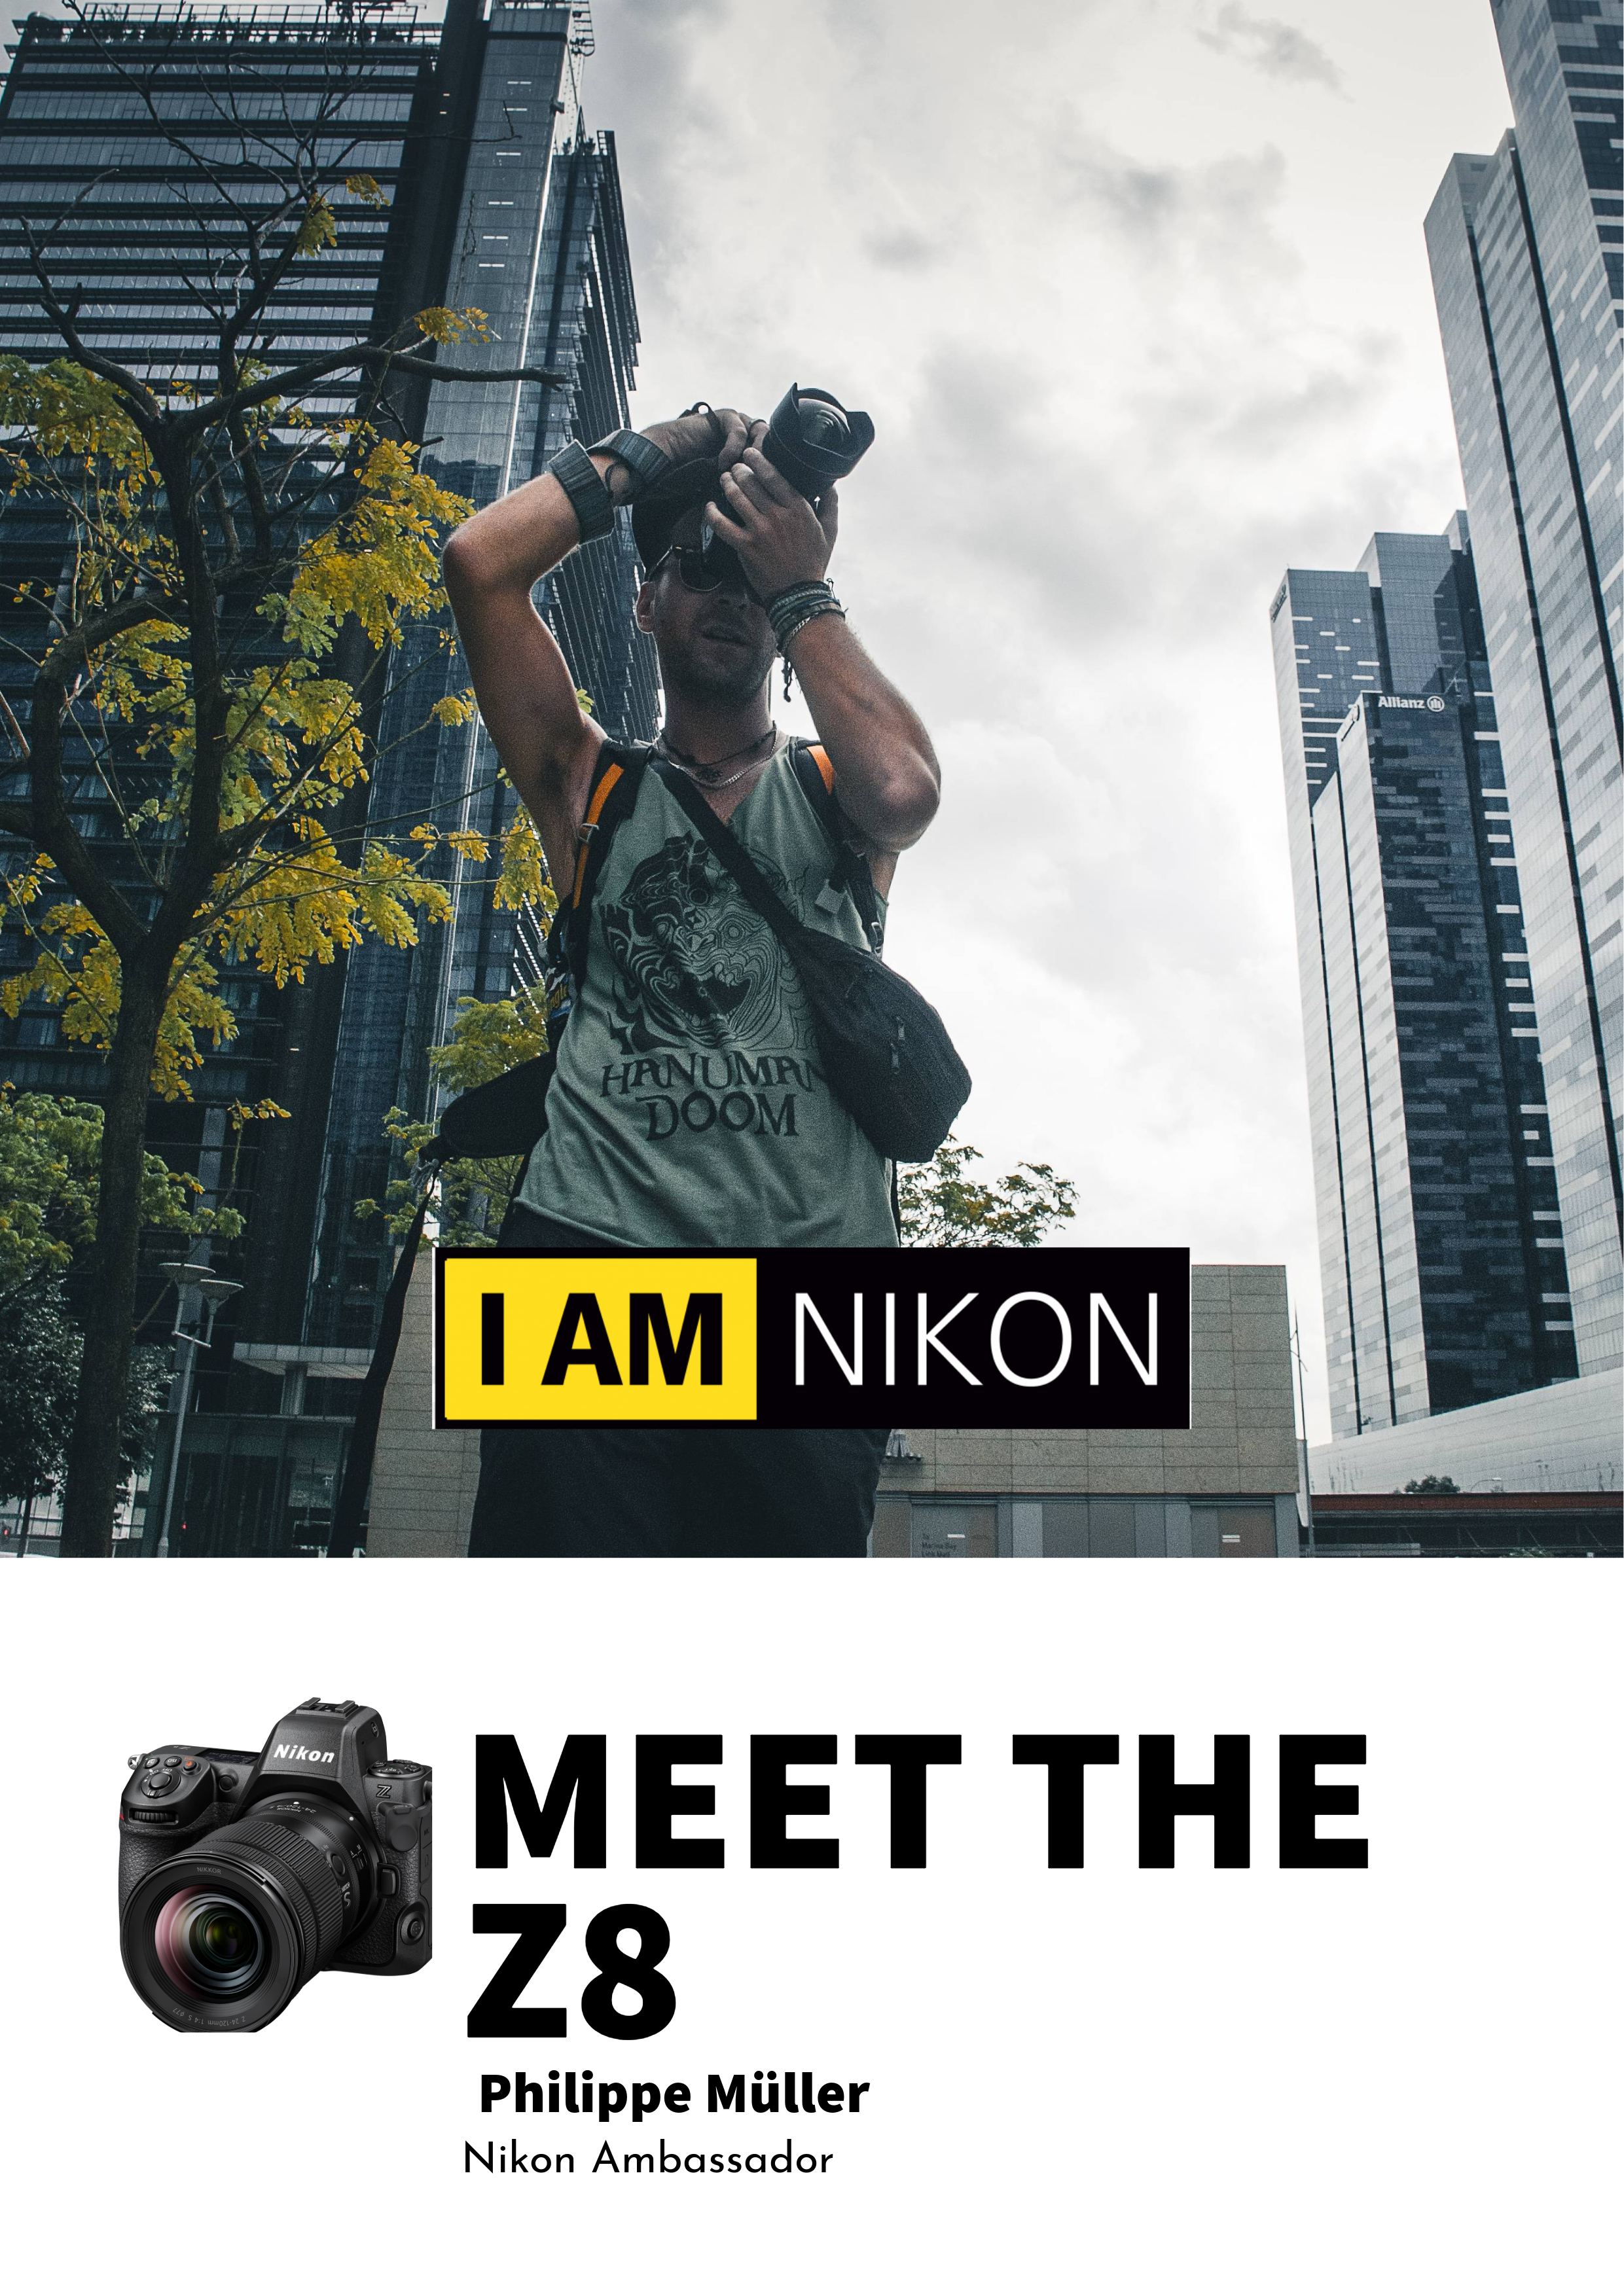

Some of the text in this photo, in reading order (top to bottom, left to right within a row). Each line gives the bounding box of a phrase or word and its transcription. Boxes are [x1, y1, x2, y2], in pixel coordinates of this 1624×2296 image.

[1378, 696, 1425, 708] Allianz
[636, 1090, 799, 1141] DOOM
[273, 1744, 334, 1763] Nikon
[208, 2018, 239, 2026] 24-120mm
